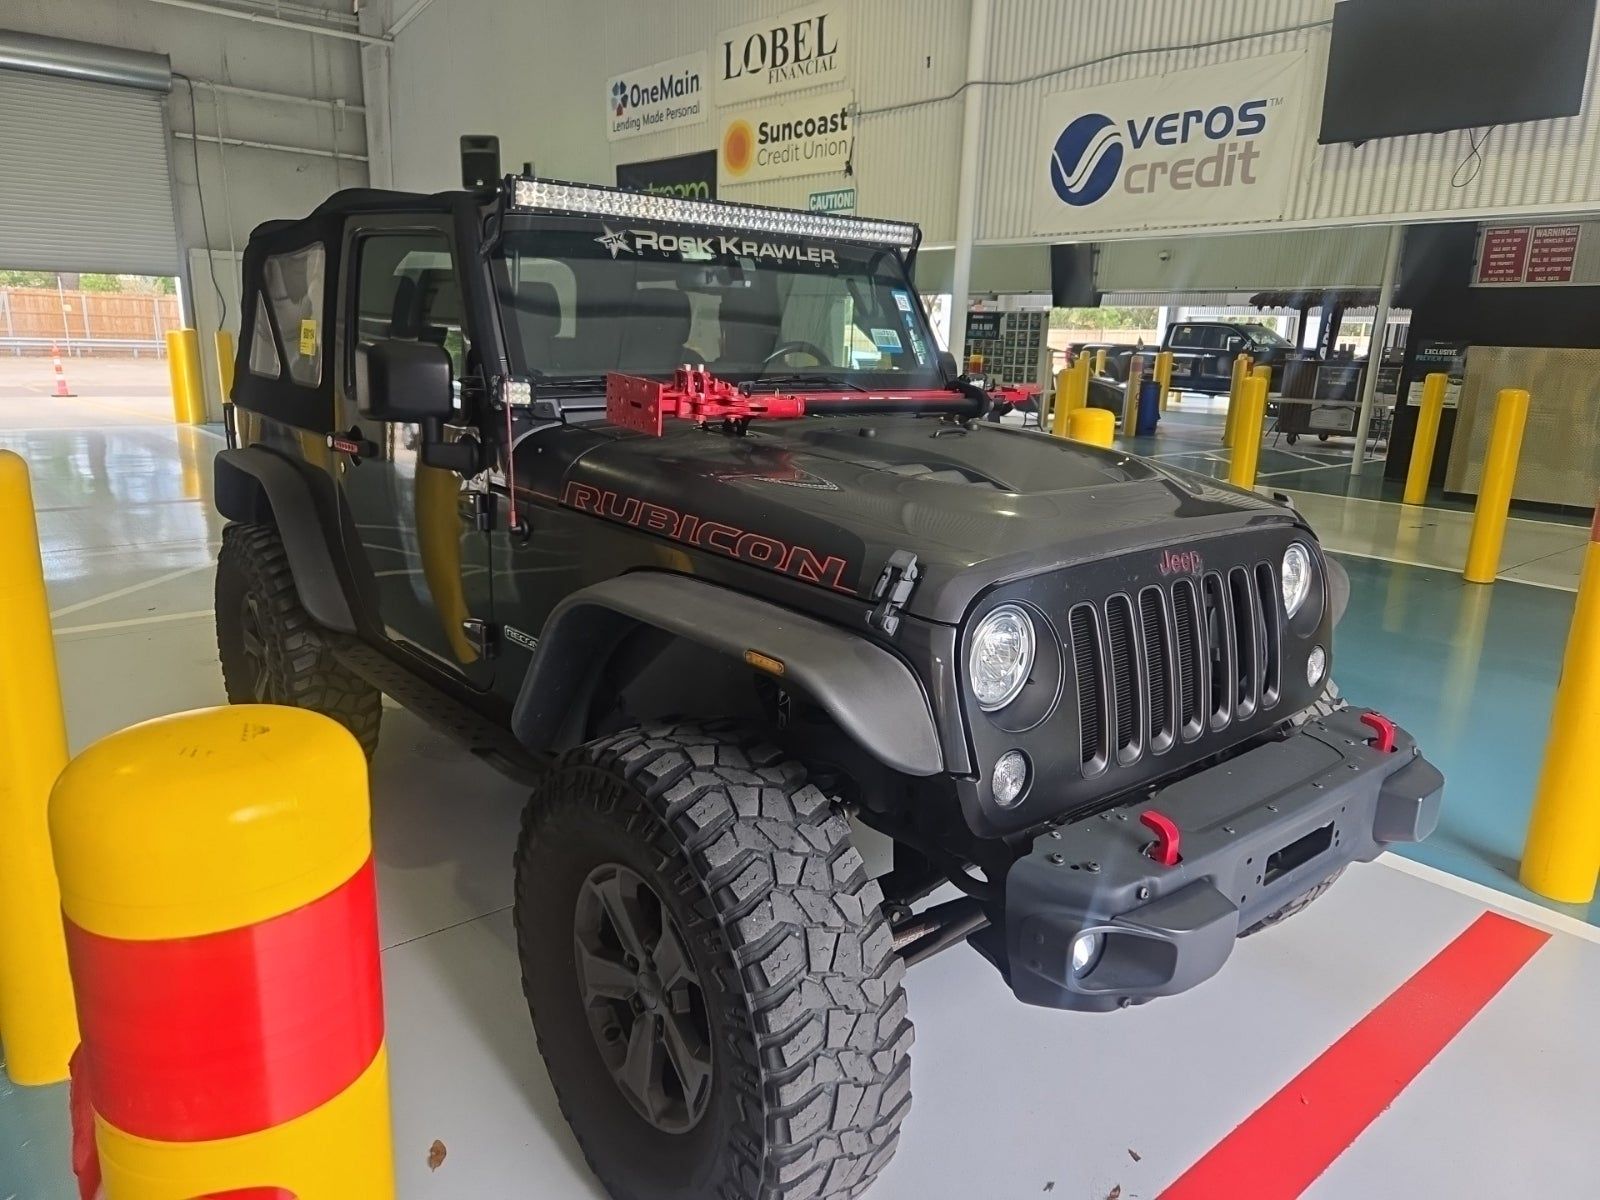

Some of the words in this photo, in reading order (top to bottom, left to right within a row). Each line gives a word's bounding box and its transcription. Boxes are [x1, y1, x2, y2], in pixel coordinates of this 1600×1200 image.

[723, 13, 839, 80] LOBEL
[768, 56, 837, 84] FINANCIAL
[630, 70, 700, 108] OneMain
[613, 117, 641, 132] Lending
[643, 111, 664, 126] Made
[666, 100, 701, 120] Personal
[757, 107, 848, 145] Suncoast
[757, 144, 800, 166] Credit
[803, 139, 848, 160] Union
[1124, 141, 1261, 194] credit
[809, 191, 854, 211] CAUTION!
[716, 236, 839, 264] KRAWLER
[563, 481, 858, 594] RUBICON
[1158, 549, 1202, 577] Jeep
